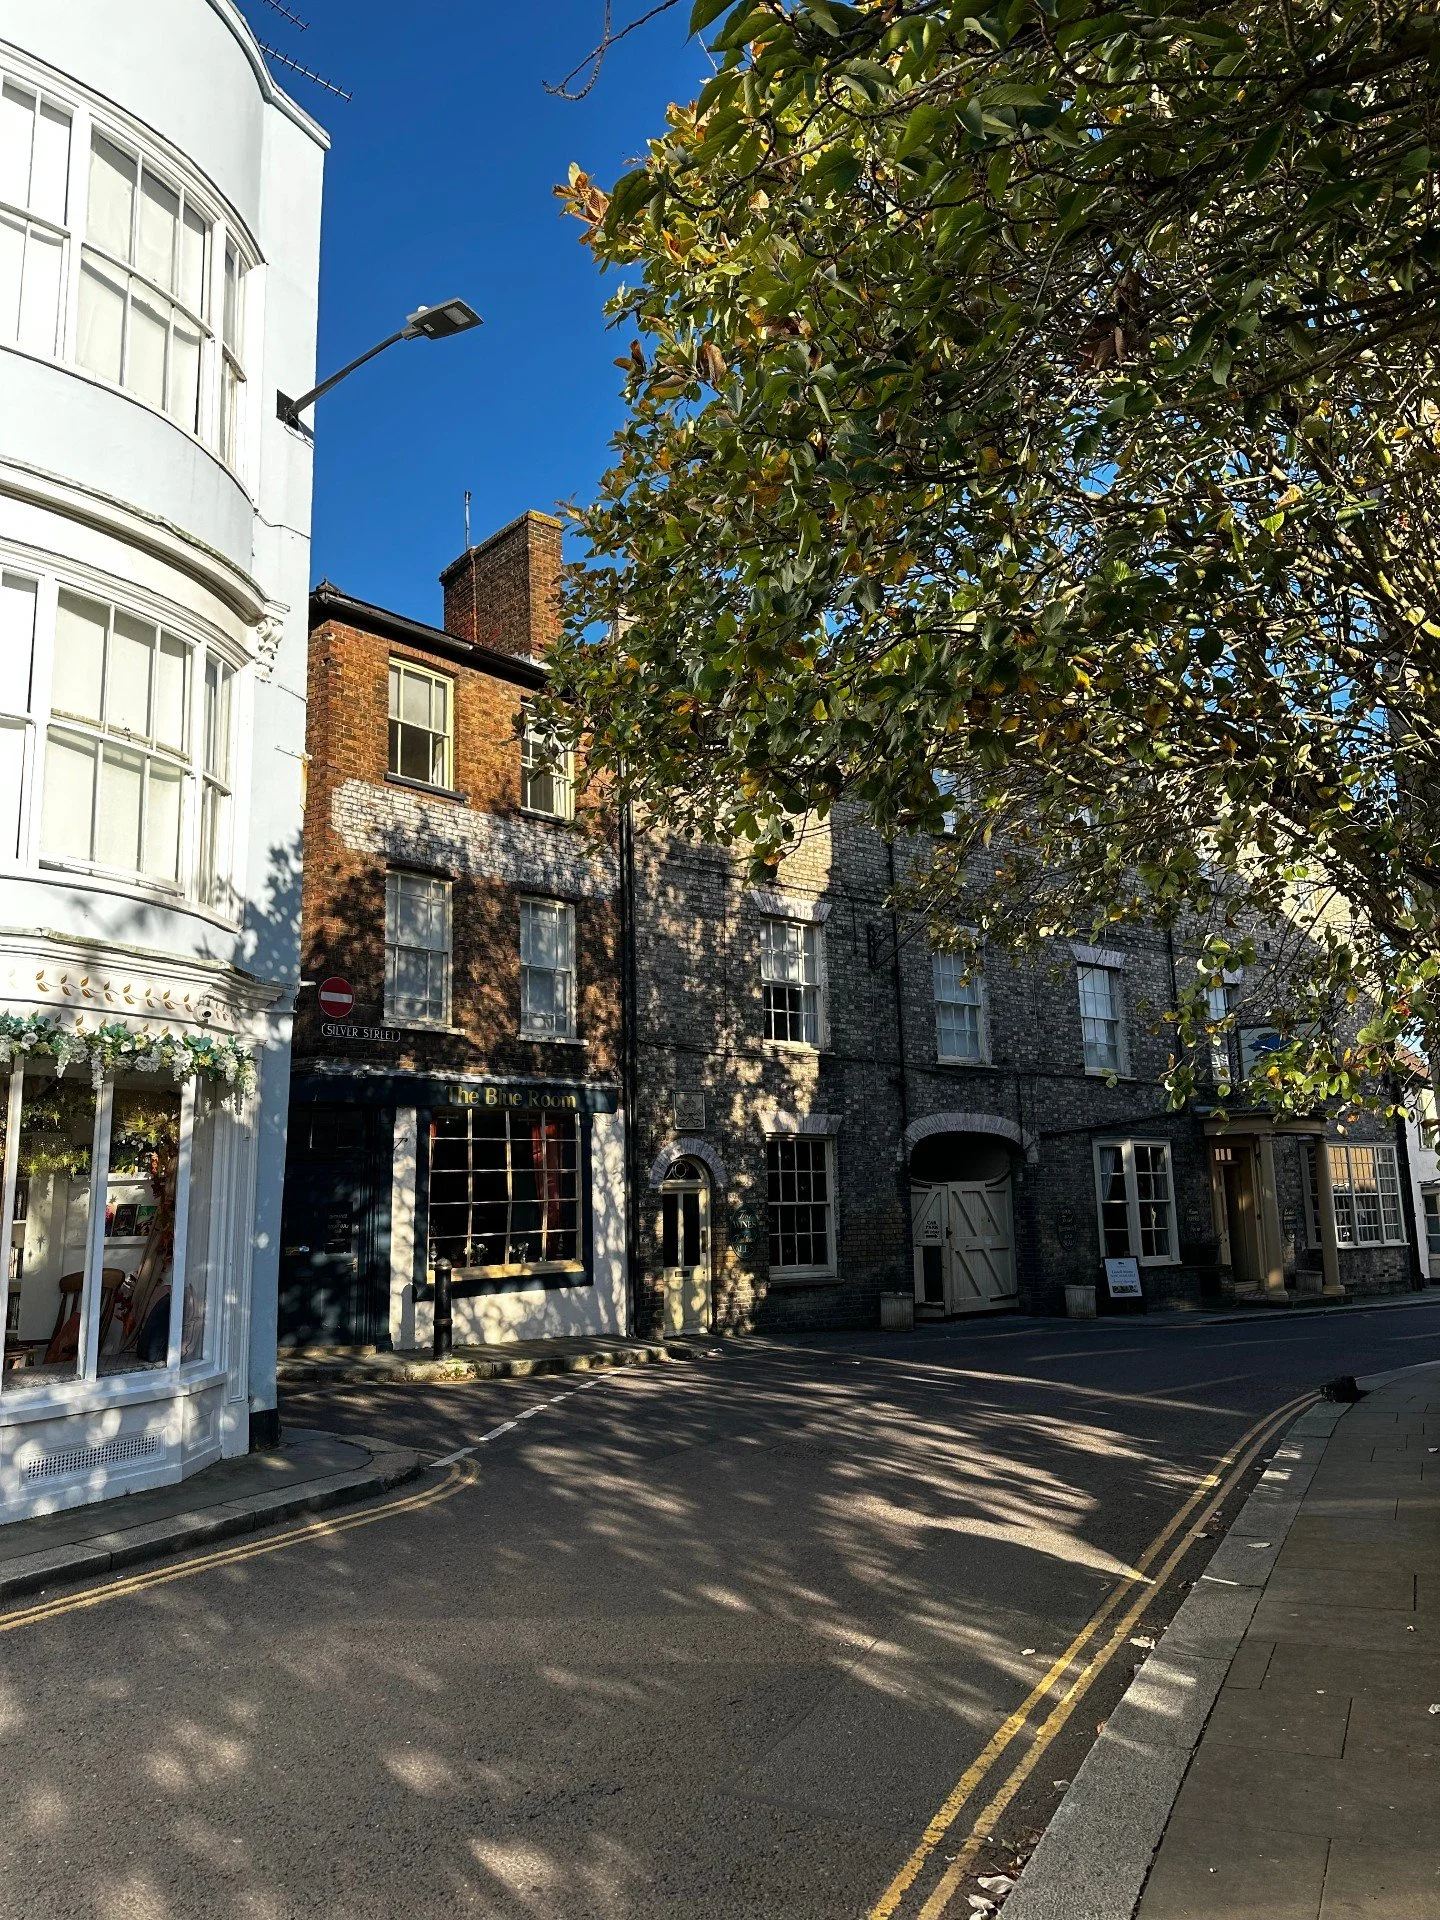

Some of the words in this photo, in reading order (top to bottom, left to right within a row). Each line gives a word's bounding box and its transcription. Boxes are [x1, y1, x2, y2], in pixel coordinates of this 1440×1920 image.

[326, 1025, 359, 1037] SILVER
[363, 1028, 395, 1040] STREET
[445, 1085, 480, 1105] The
[484, 1086, 523, 1106] Blue
[528, 1089, 577, 1108] Room
[732, 1220, 757, 1229] WINES
